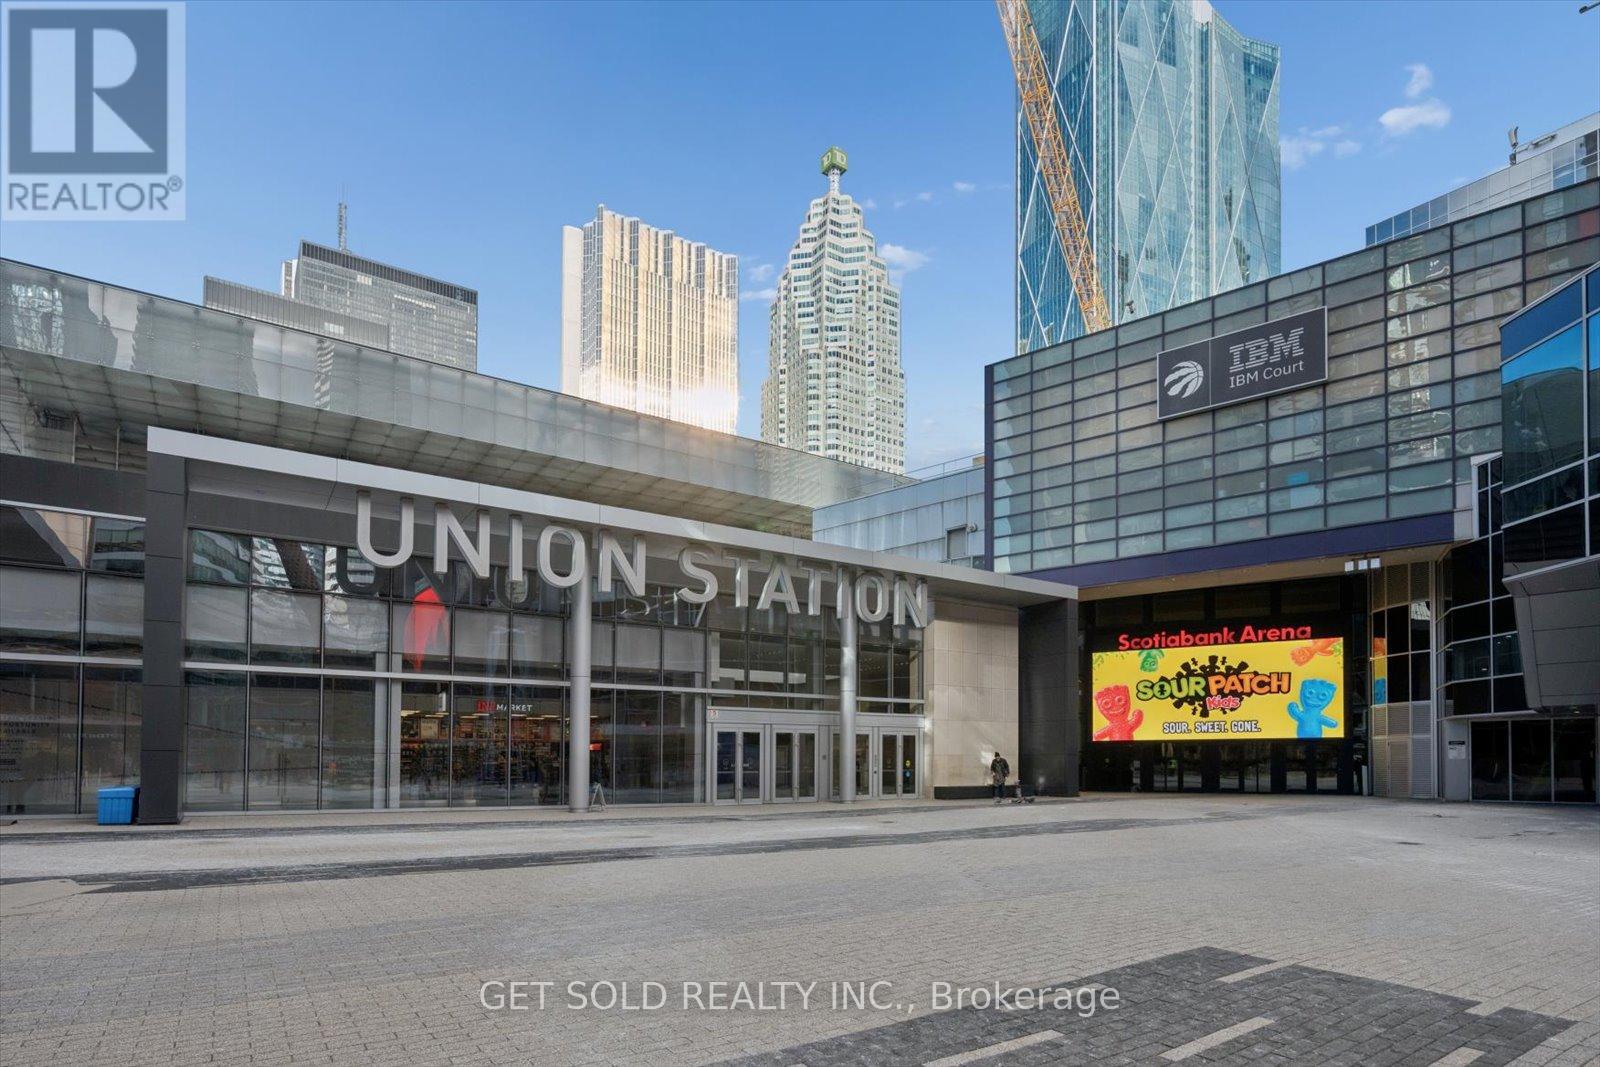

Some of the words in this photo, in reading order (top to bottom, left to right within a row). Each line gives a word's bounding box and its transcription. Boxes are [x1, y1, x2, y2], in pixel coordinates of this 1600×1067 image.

[1229, 327, 1304, 373] IBM
[1229, 370, 1259, 389] IBM
[1263, 360, 1304, 380] Court
[356, 488, 646, 598] UNION
[677, 541, 929, 630] STATION
[1118, 627, 1235, 650] Scotiabank
[1240, 625, 1311, 642] Arena
[1136, 675, 1206, 701] SOUR
[1207, 671, 1292, 696] PATCH
[1206, 695, 1241, 711] Kids
[1163, 721, 1192, 734] SOUR.
[1195, 720, 1228, 733] SWEET.
[1231, 719, 1261, 733] GONE.
